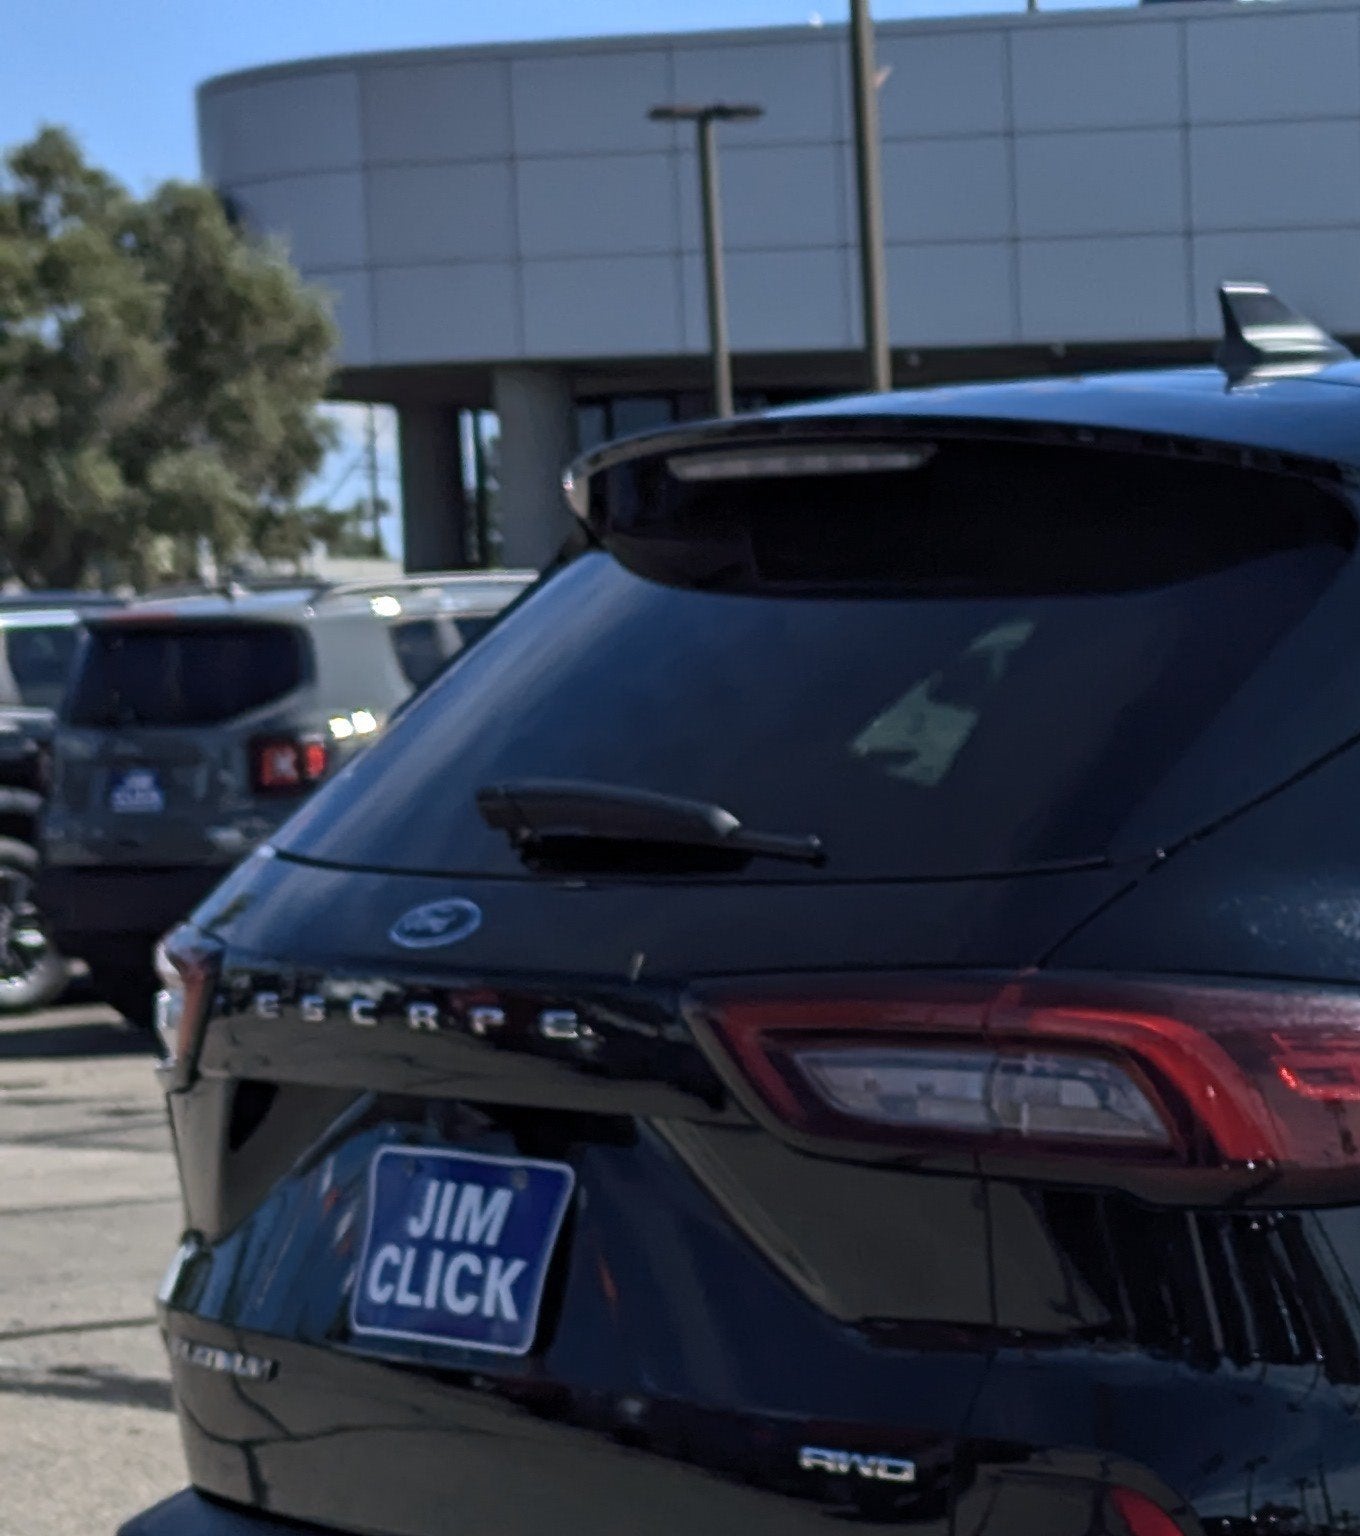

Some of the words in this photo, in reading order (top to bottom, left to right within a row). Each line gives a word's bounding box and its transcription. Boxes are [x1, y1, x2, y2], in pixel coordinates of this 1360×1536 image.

[407, 1178, 514, 1247] JIM
[368, 1243, 528, 1323] CLICK
[801, 1445, 915, 1482] AWD
